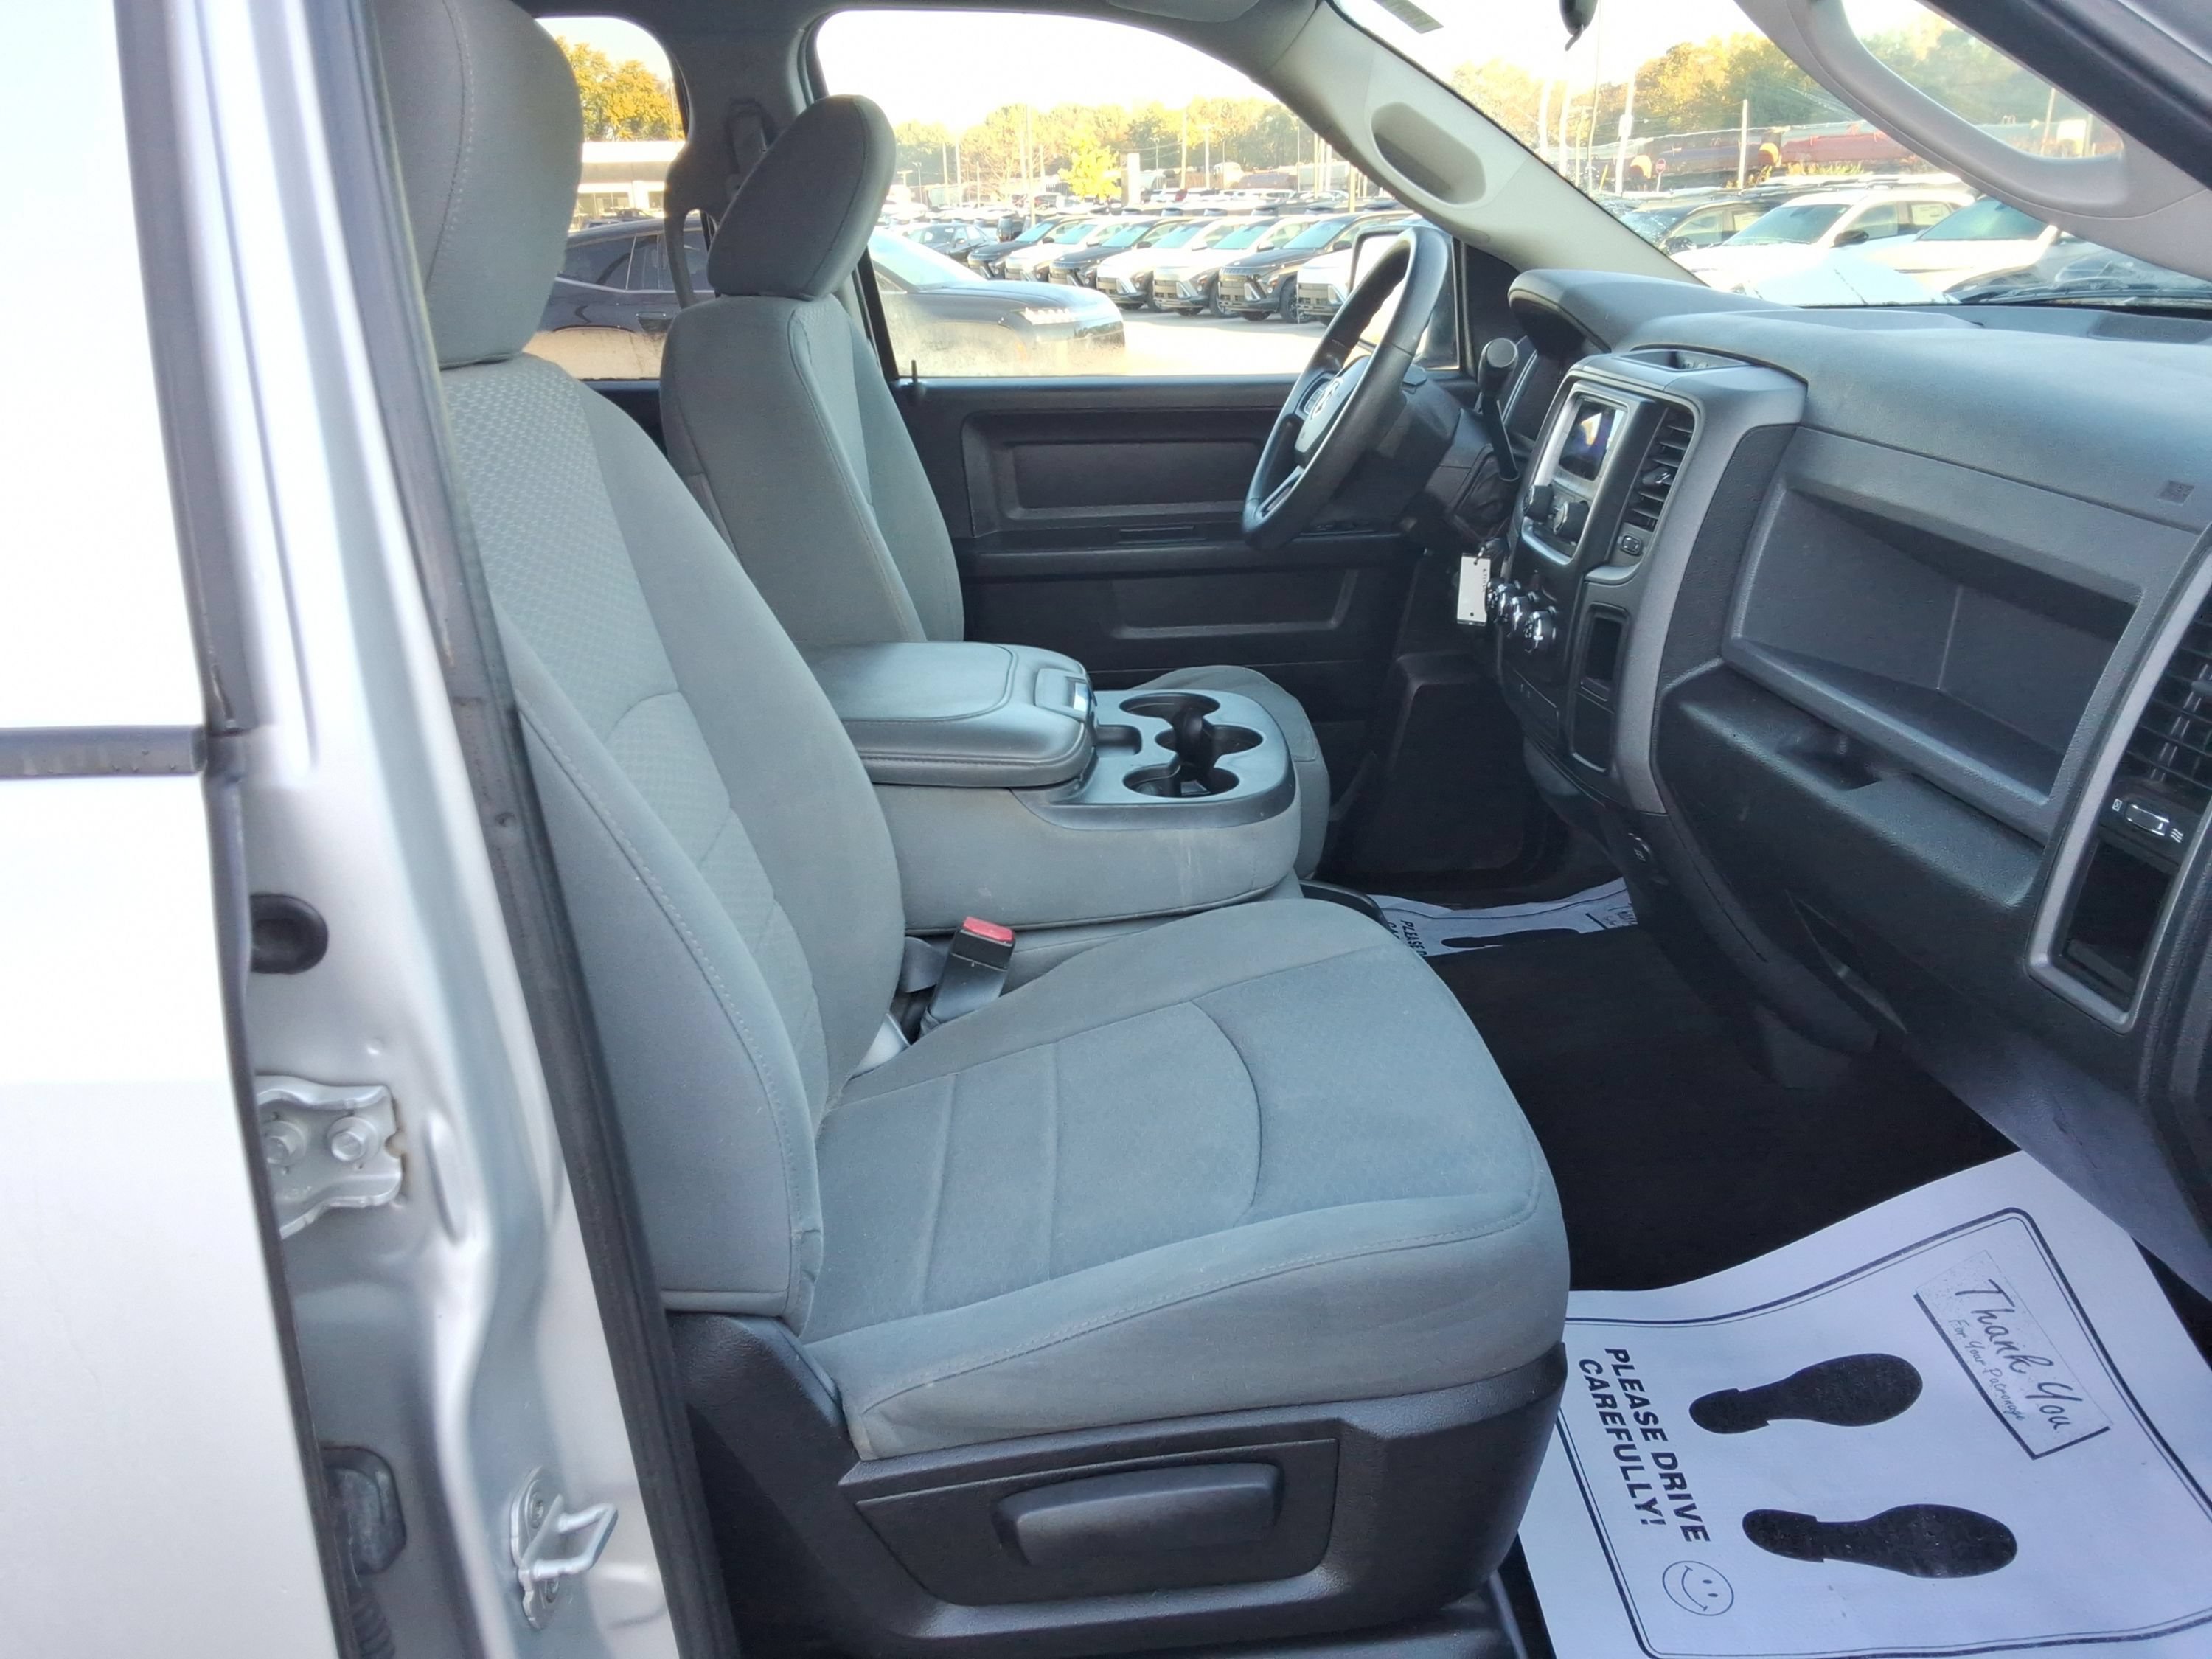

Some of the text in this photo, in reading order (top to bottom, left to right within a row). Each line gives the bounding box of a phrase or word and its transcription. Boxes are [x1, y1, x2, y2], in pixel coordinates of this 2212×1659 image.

[1948, 1319, 1970, 1339] For
[1983, 1367, 2025, 1422] Patronage
[1955, 1279, 2084, 1430] Thank You
[1579, 1360, 1666, 1525] CAREFULLY!
[1605, 1348, 1711, 1542] PLEASE DRIVE
